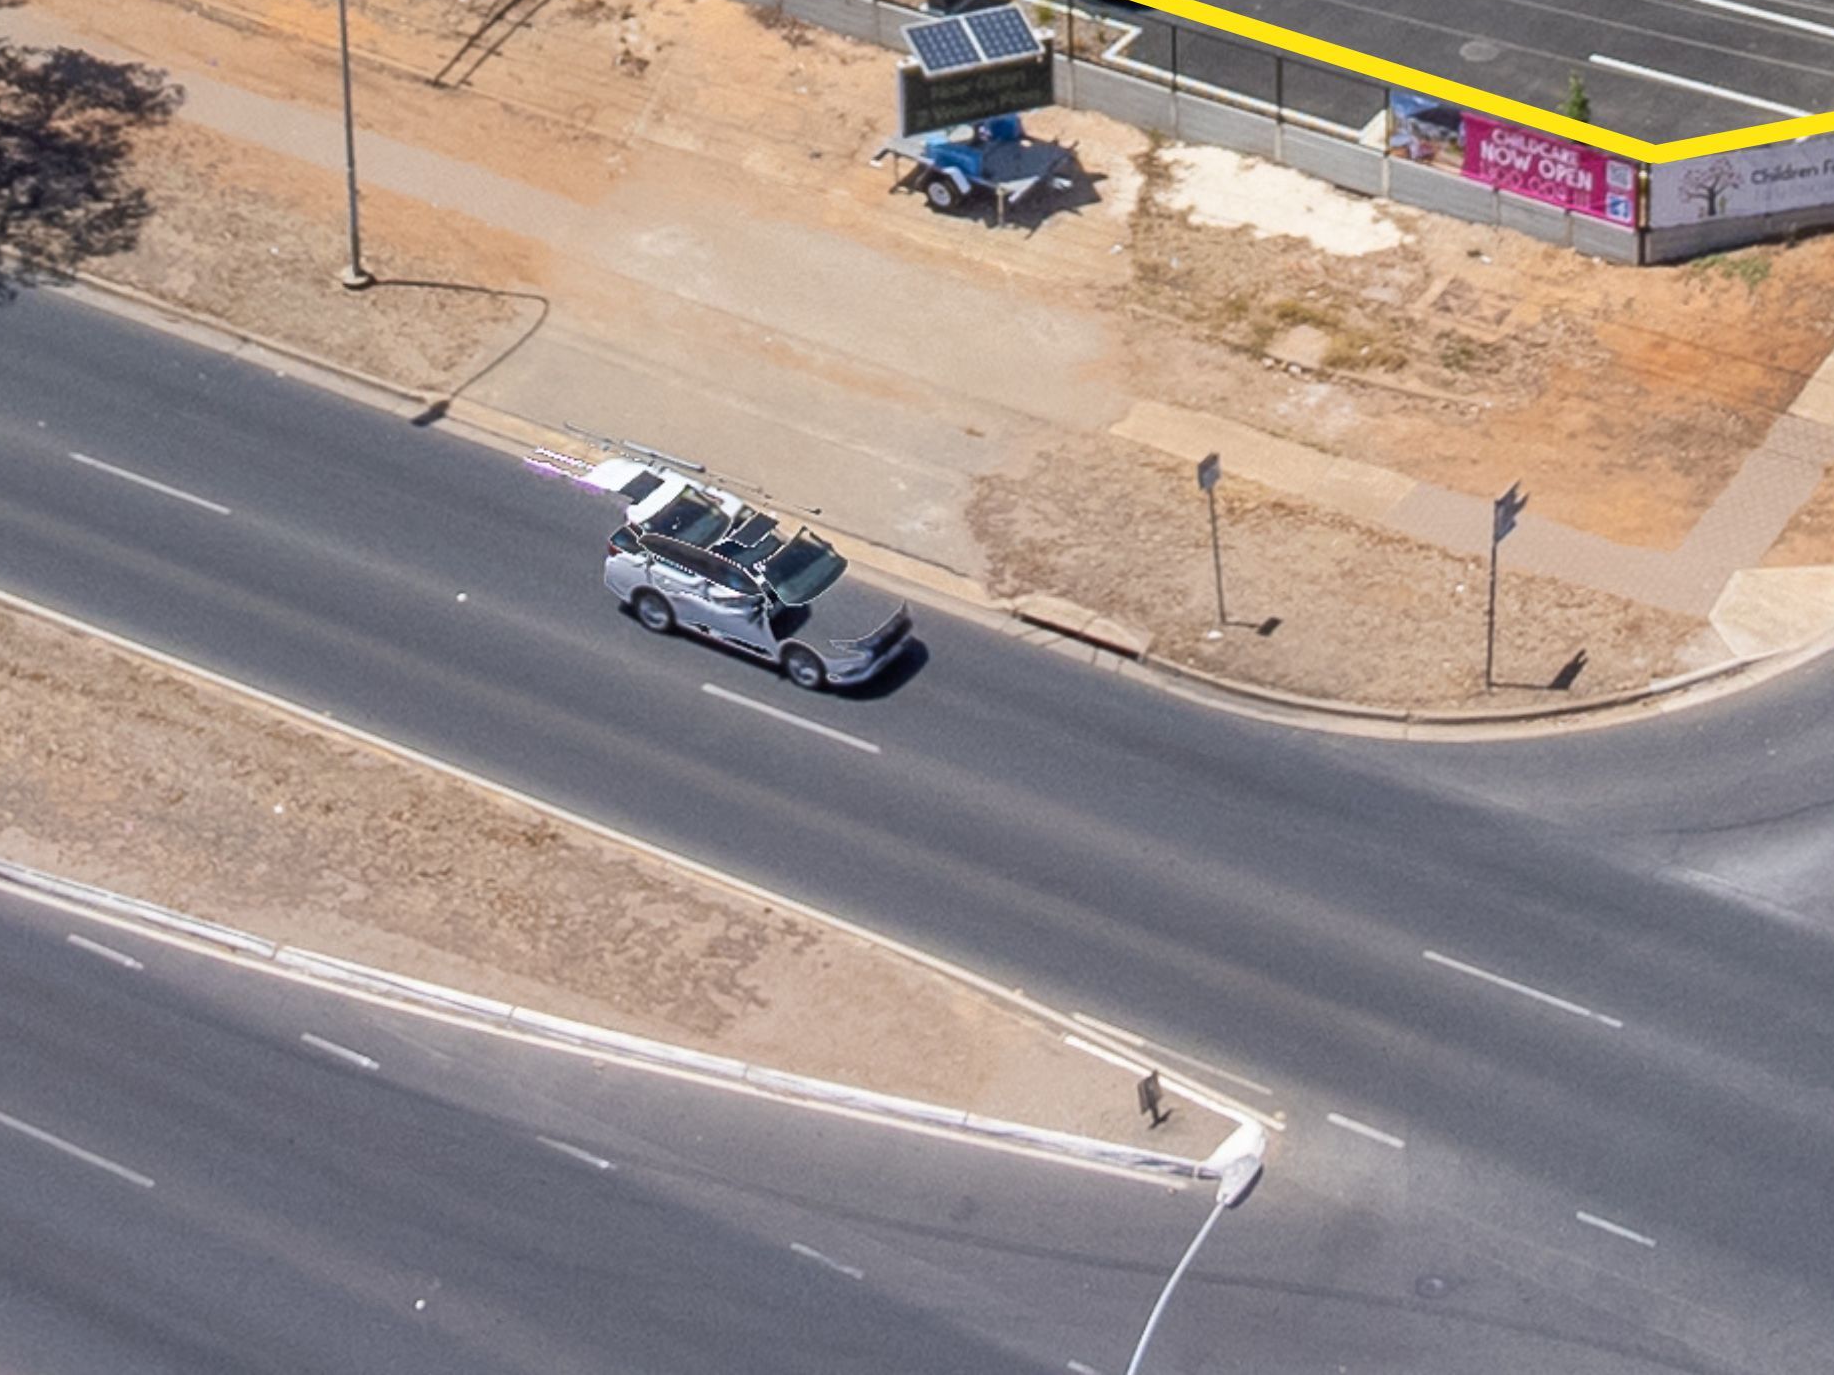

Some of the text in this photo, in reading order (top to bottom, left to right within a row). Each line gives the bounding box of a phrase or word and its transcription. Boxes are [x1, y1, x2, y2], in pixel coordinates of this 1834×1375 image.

[1479, 139, 1593, 191] NOW OPEN
[1491, 127, 1580, 165] CHILDCARE
[1750, 161, 1819, 186] Children
